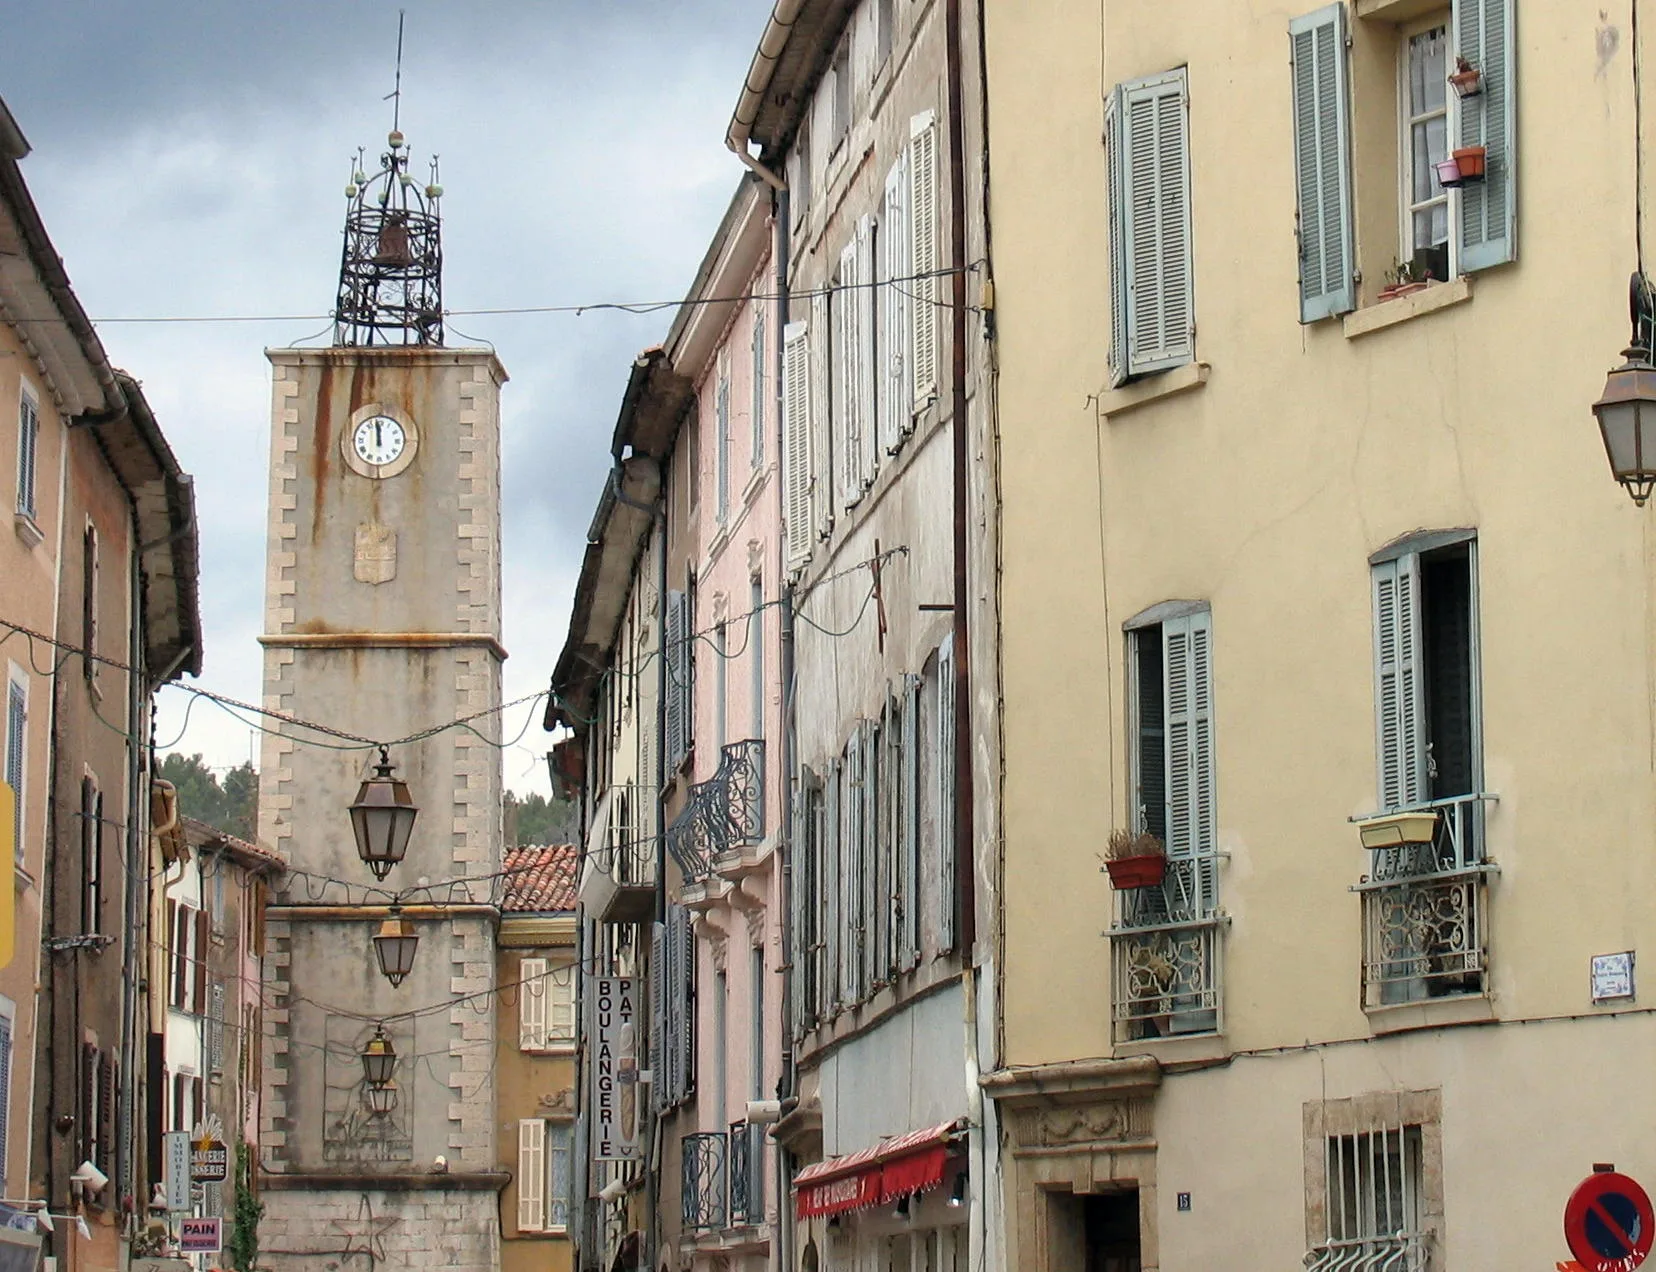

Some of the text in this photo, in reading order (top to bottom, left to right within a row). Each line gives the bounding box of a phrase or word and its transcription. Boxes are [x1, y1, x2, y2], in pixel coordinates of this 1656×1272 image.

[619, 979, 633, 1023] PAT
[598, 980, 612, 1157] BOULANGERIE
[1179, 1194, 1189, 1208] 15
[183, 1223, 216, 1235] PAIN
